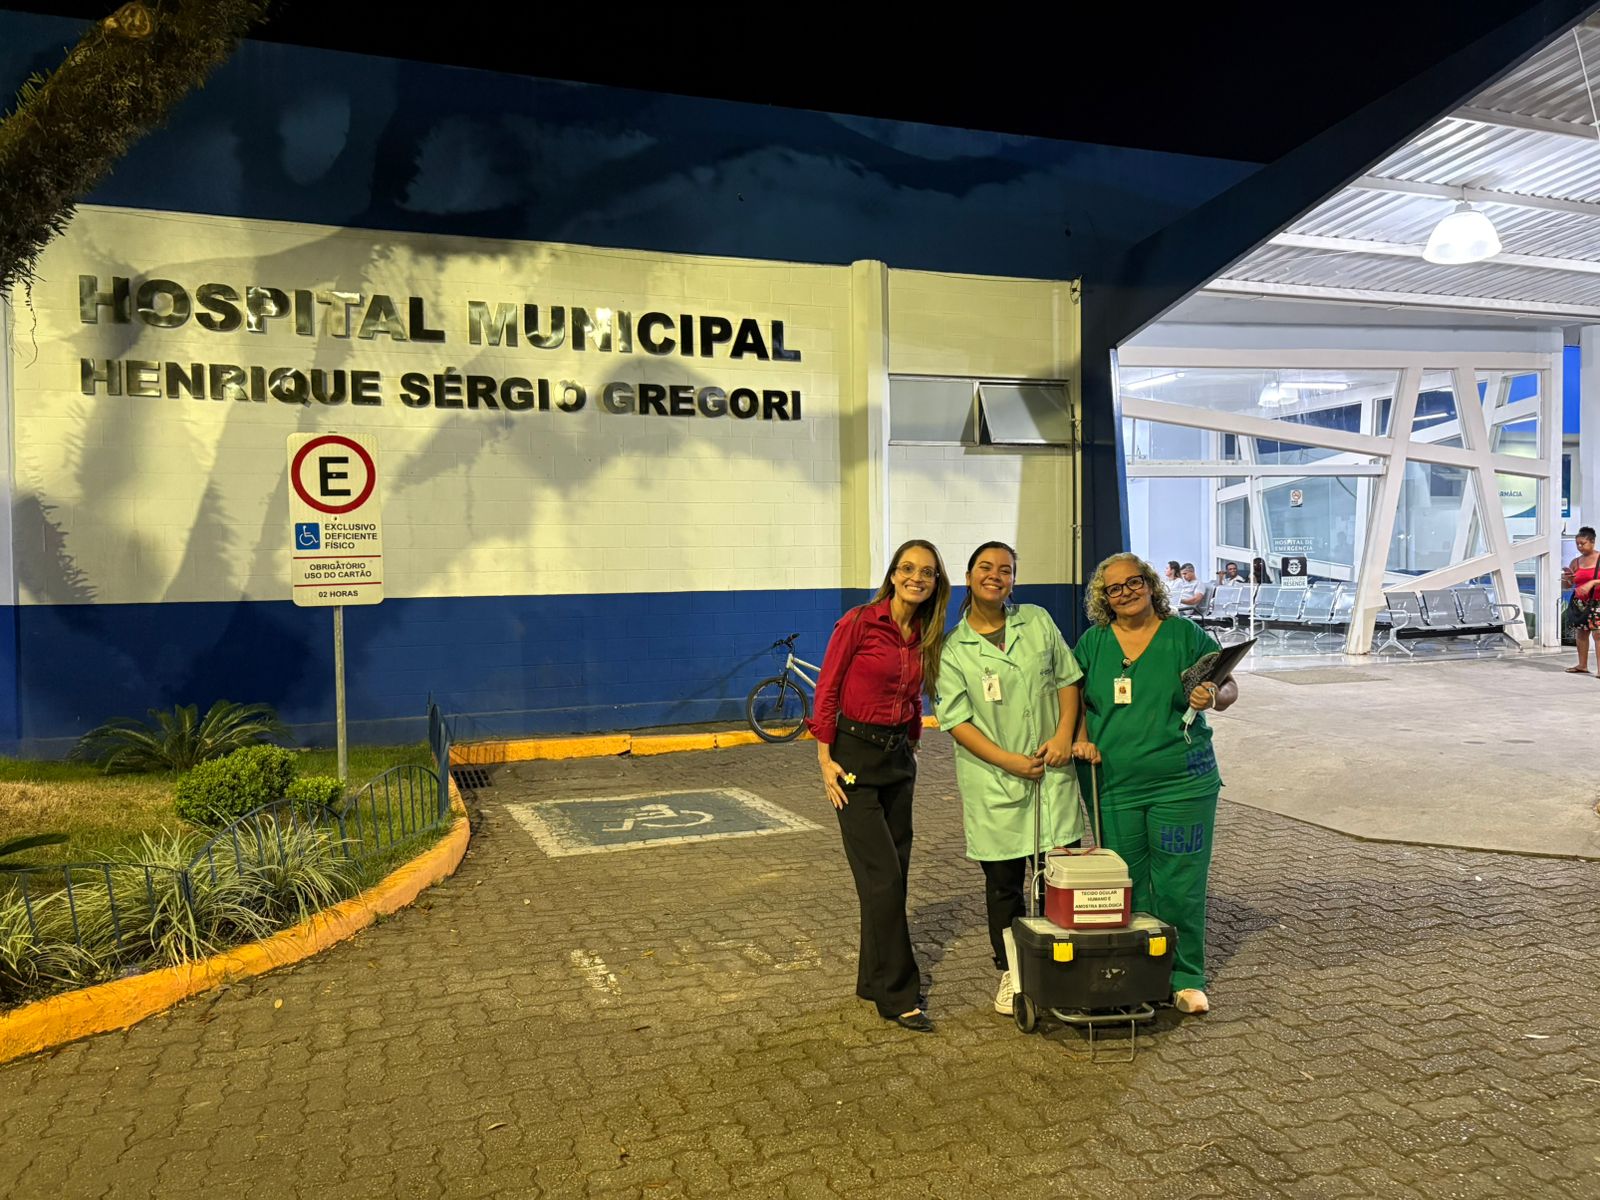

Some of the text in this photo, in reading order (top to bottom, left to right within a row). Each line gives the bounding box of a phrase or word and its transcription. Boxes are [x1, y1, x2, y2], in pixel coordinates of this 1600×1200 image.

[78, 274, 802, 362] HOSPITAL MUNICIPAL
[80, 358, 802, 422] HENRIQUE SÉRGIO GREGORI
[319, 457, 351, 496] E
[325, 523, 376, 531] EXCLUSIVO
[325, 541, 355, 549] FÍSICO
[310, 562, 366, 571] OBRIGATÓRIO
[338, 569, 372, 578] CARTÃO
